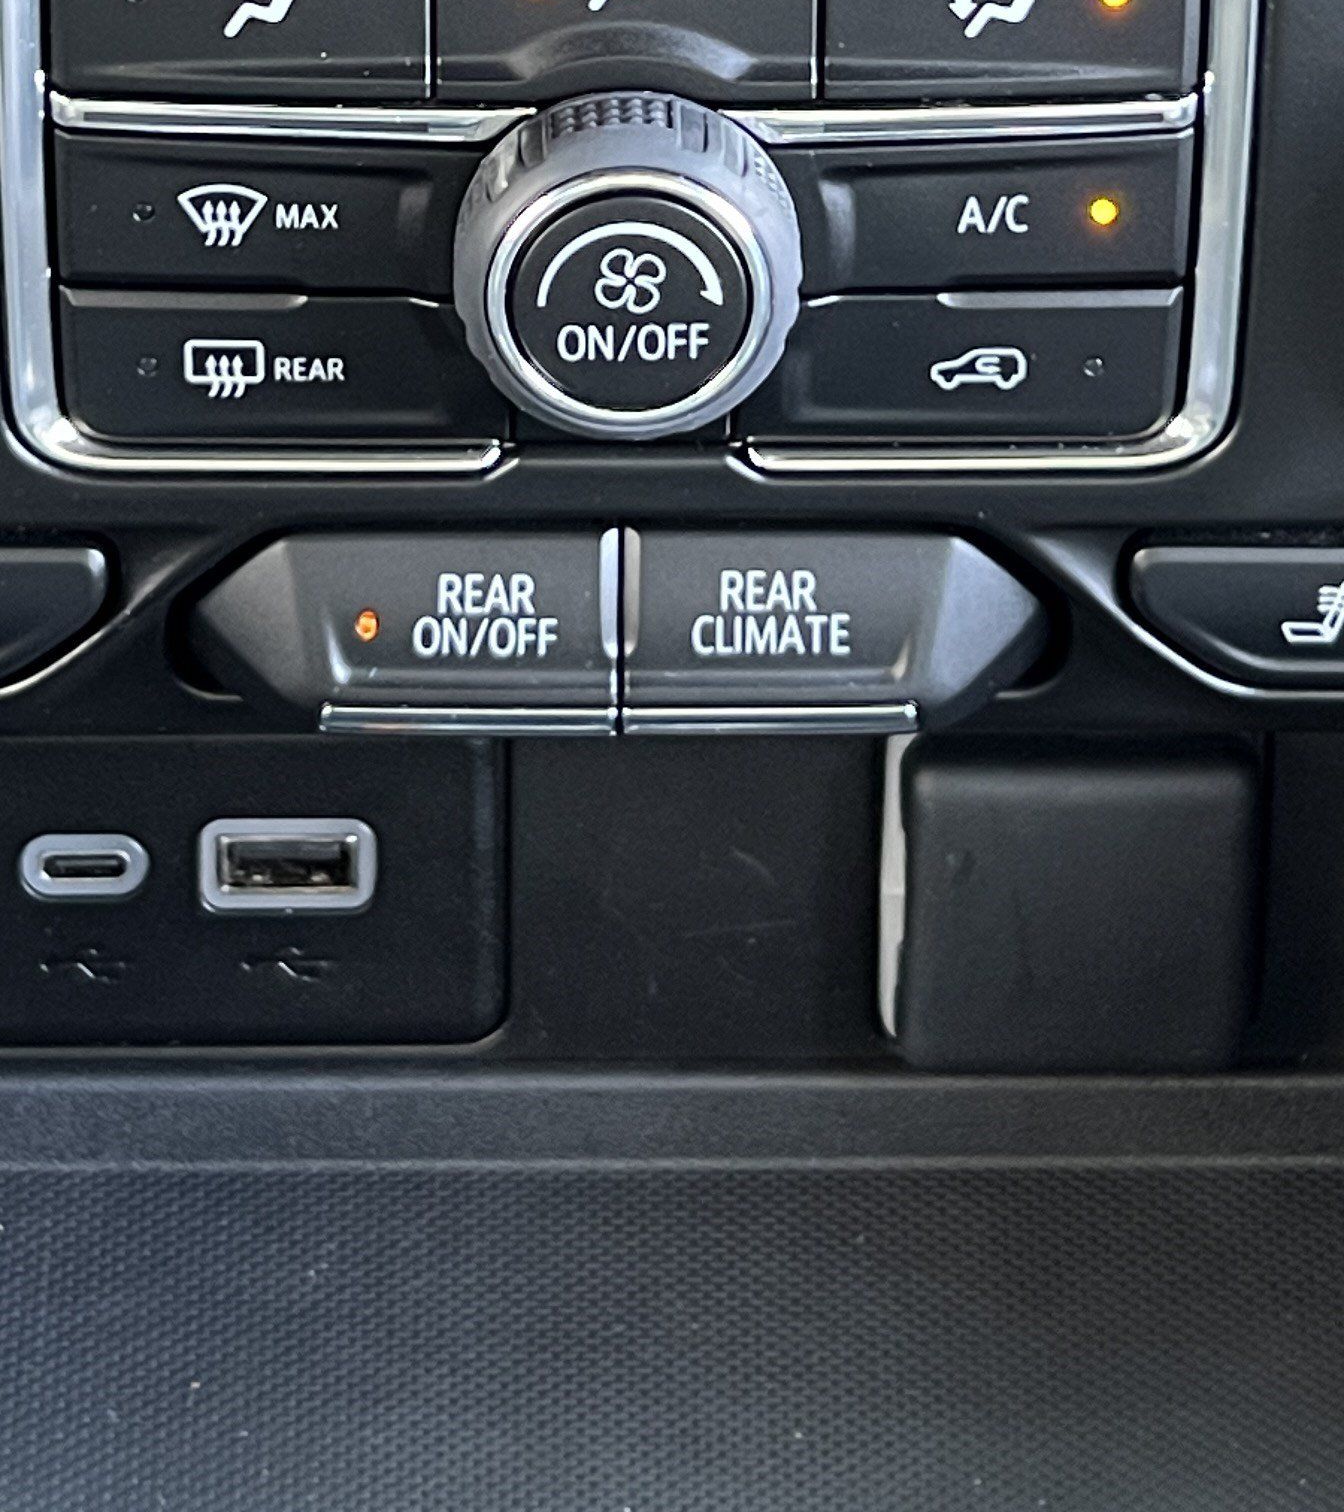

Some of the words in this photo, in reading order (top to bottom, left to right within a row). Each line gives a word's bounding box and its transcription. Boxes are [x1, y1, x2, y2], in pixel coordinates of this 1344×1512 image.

[275, 202, 340, 230] MAX
[957, 194, 1030, 234] A/C
[556, 322, 711, 363] ON/OFF
[273, 355, 346, 383] REAR
[436, 572, 537, 615] REAR
[719, 569, 819, 612] REAR
[412, 615, 559, 658] ON/OFF
[691, 611, 851, 657] CLIMATE
